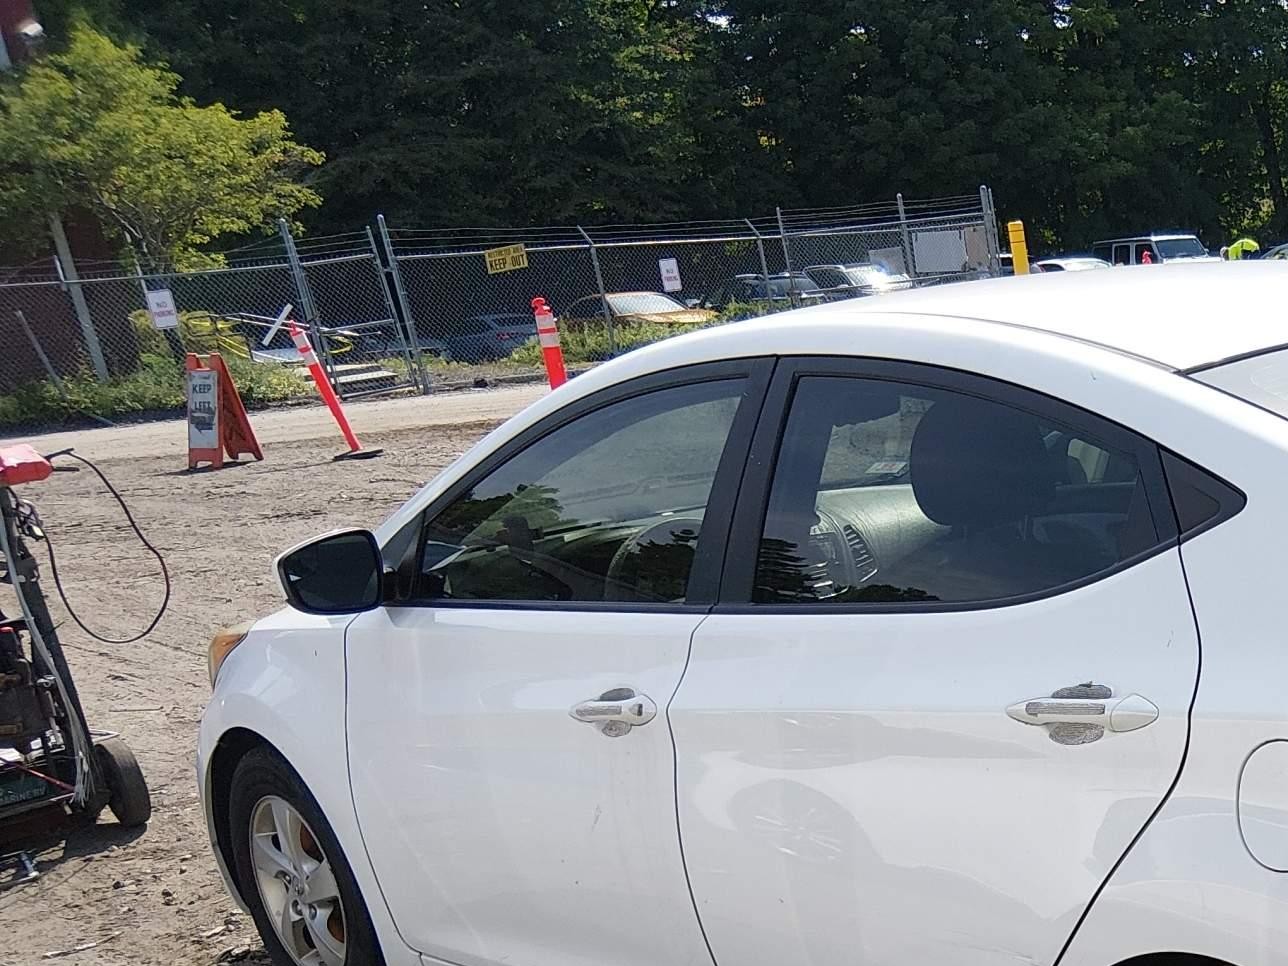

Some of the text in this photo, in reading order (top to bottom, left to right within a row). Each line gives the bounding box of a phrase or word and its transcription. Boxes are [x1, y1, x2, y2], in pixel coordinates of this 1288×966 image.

[489, 254, 525, 272] KEEP OUT
[192, 383, 212, 394] KEEP
